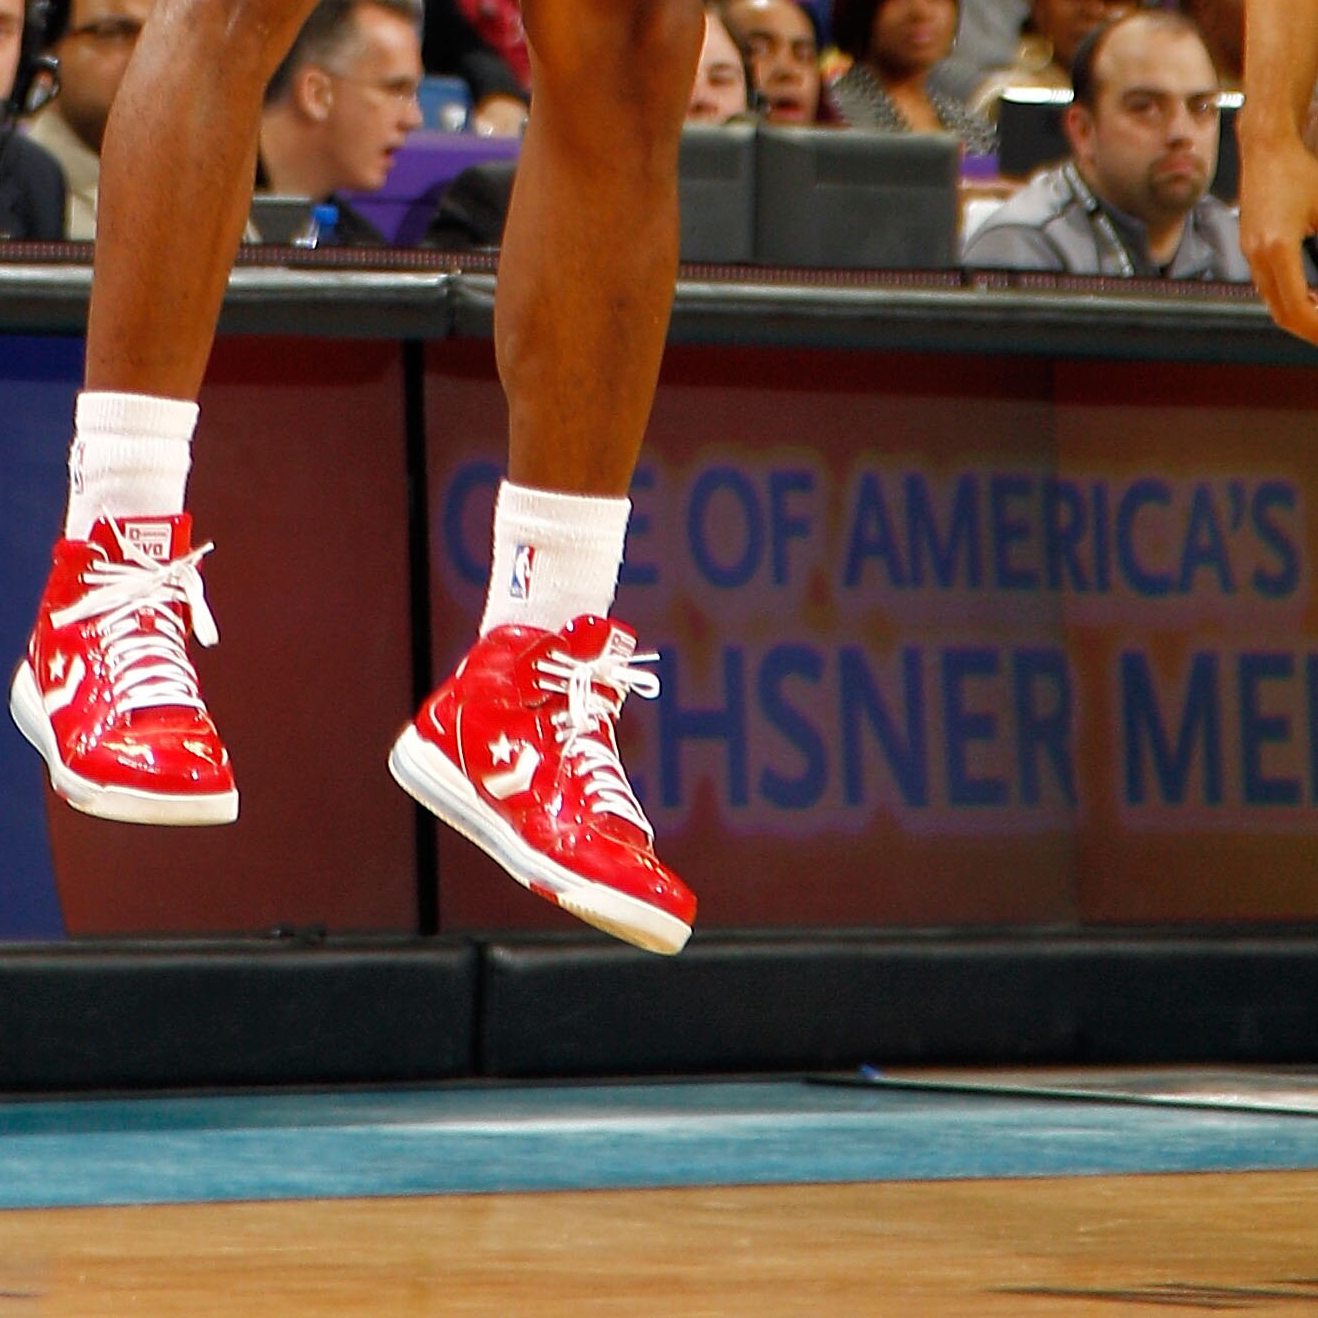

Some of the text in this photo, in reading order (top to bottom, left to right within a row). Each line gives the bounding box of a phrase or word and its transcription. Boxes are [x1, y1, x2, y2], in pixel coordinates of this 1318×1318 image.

[687, 464, 813, 590] OF
[844, 471, 1301, 597] AMERICA'S
[633, 642, 1318, 810] HSNER ME
